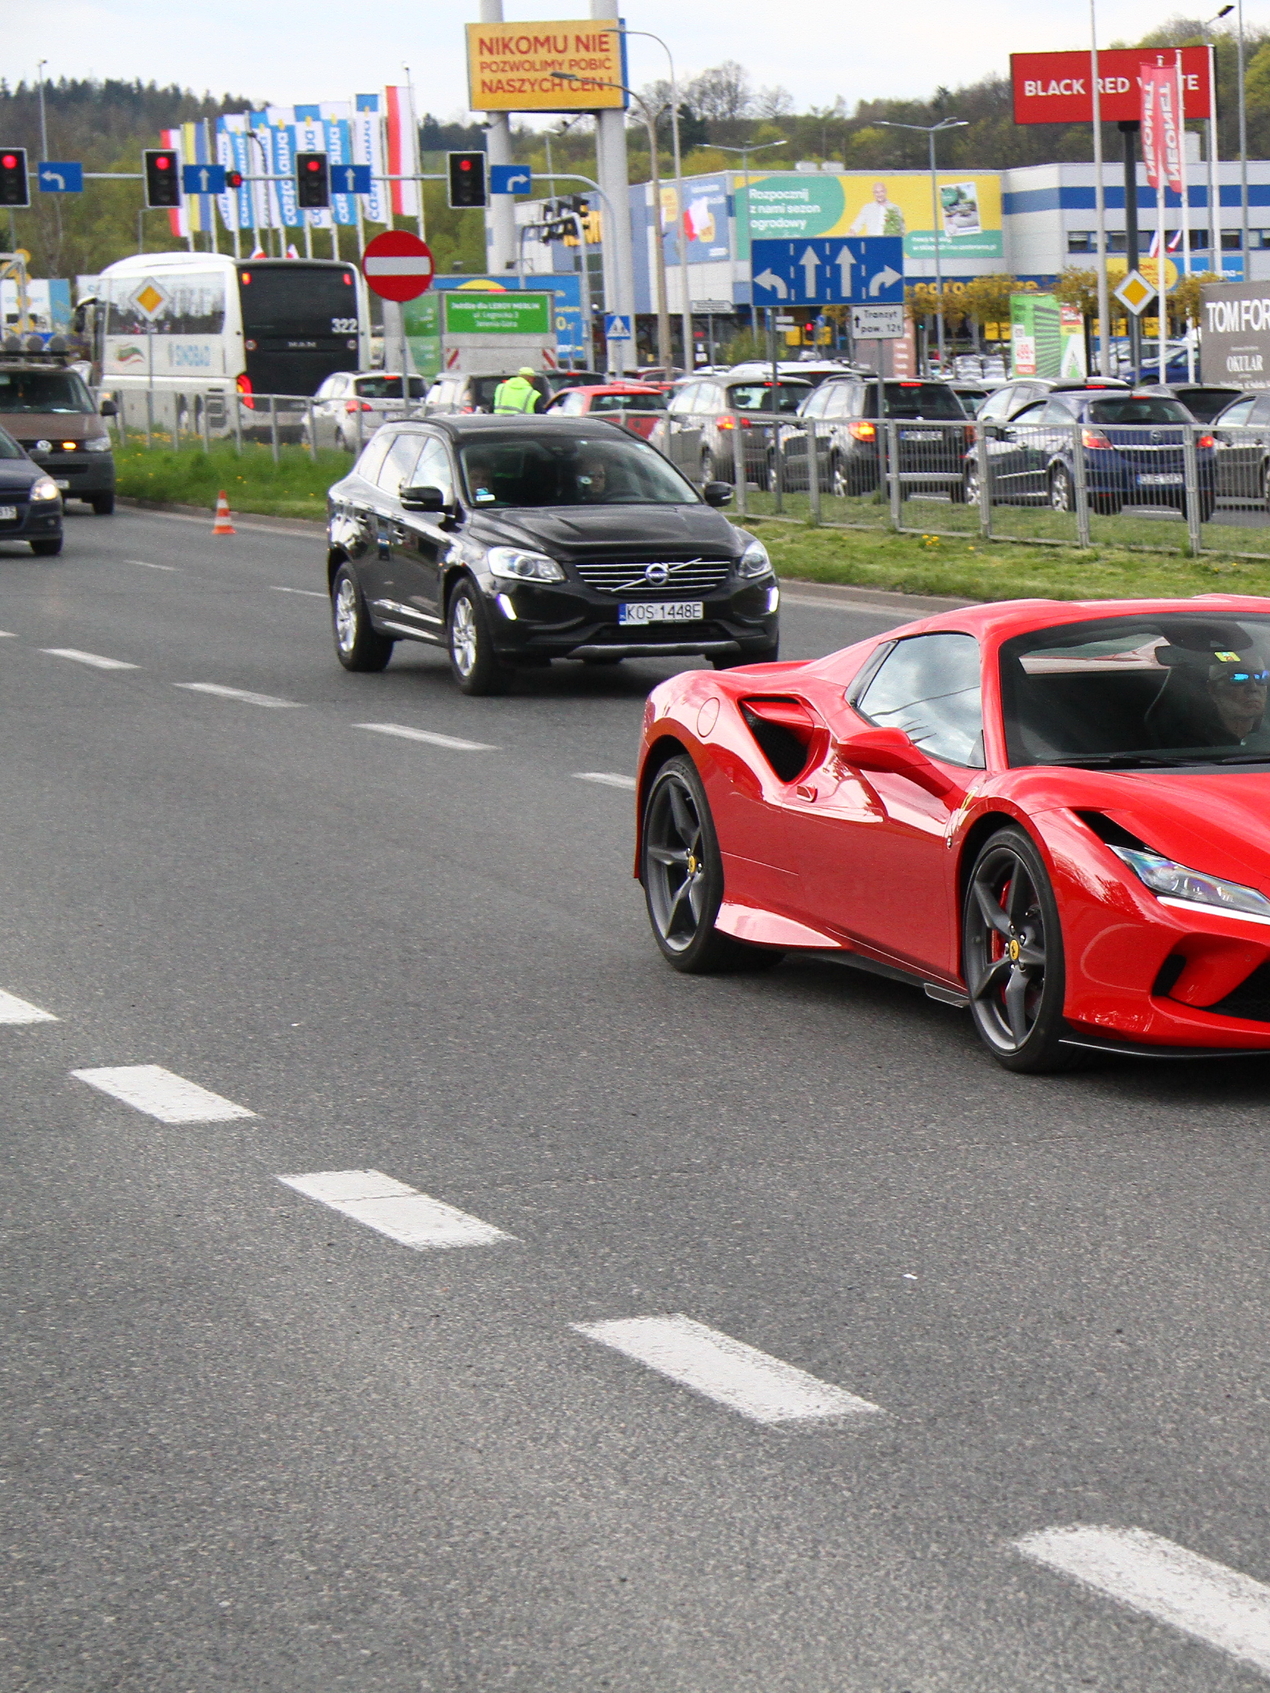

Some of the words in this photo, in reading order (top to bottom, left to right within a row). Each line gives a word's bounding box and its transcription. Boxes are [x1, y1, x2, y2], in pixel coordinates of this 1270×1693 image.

[478, 35, 569, 56] NIKOMU
[575, 34, 610, 53] NIE
[479, 58, 565, 73] POZWOLIMY
[568, 55, 612, 71] POBIĆ
[481, 78, 564, 94] NASZYCH
[568, 77, 604, 92] CEN
[1024, 79, 1086, 96] BLACK
[749, 188, 809, 202] Rozpocznij
[757, 203, 786, 214] nami
[786, 205, 822, 214] sezon
[750, 217, 807, 231] ogrodowy
[862, 310, 898, 320] Tranzyt
[1205, 301, 1240, 333] TOM
[331, 317, 358, 333] 322
[1226, 354, 1264, 372] OKULAR
[627, 605, 655, 620] KOS
[660, 603, 701, 619] 1448E
